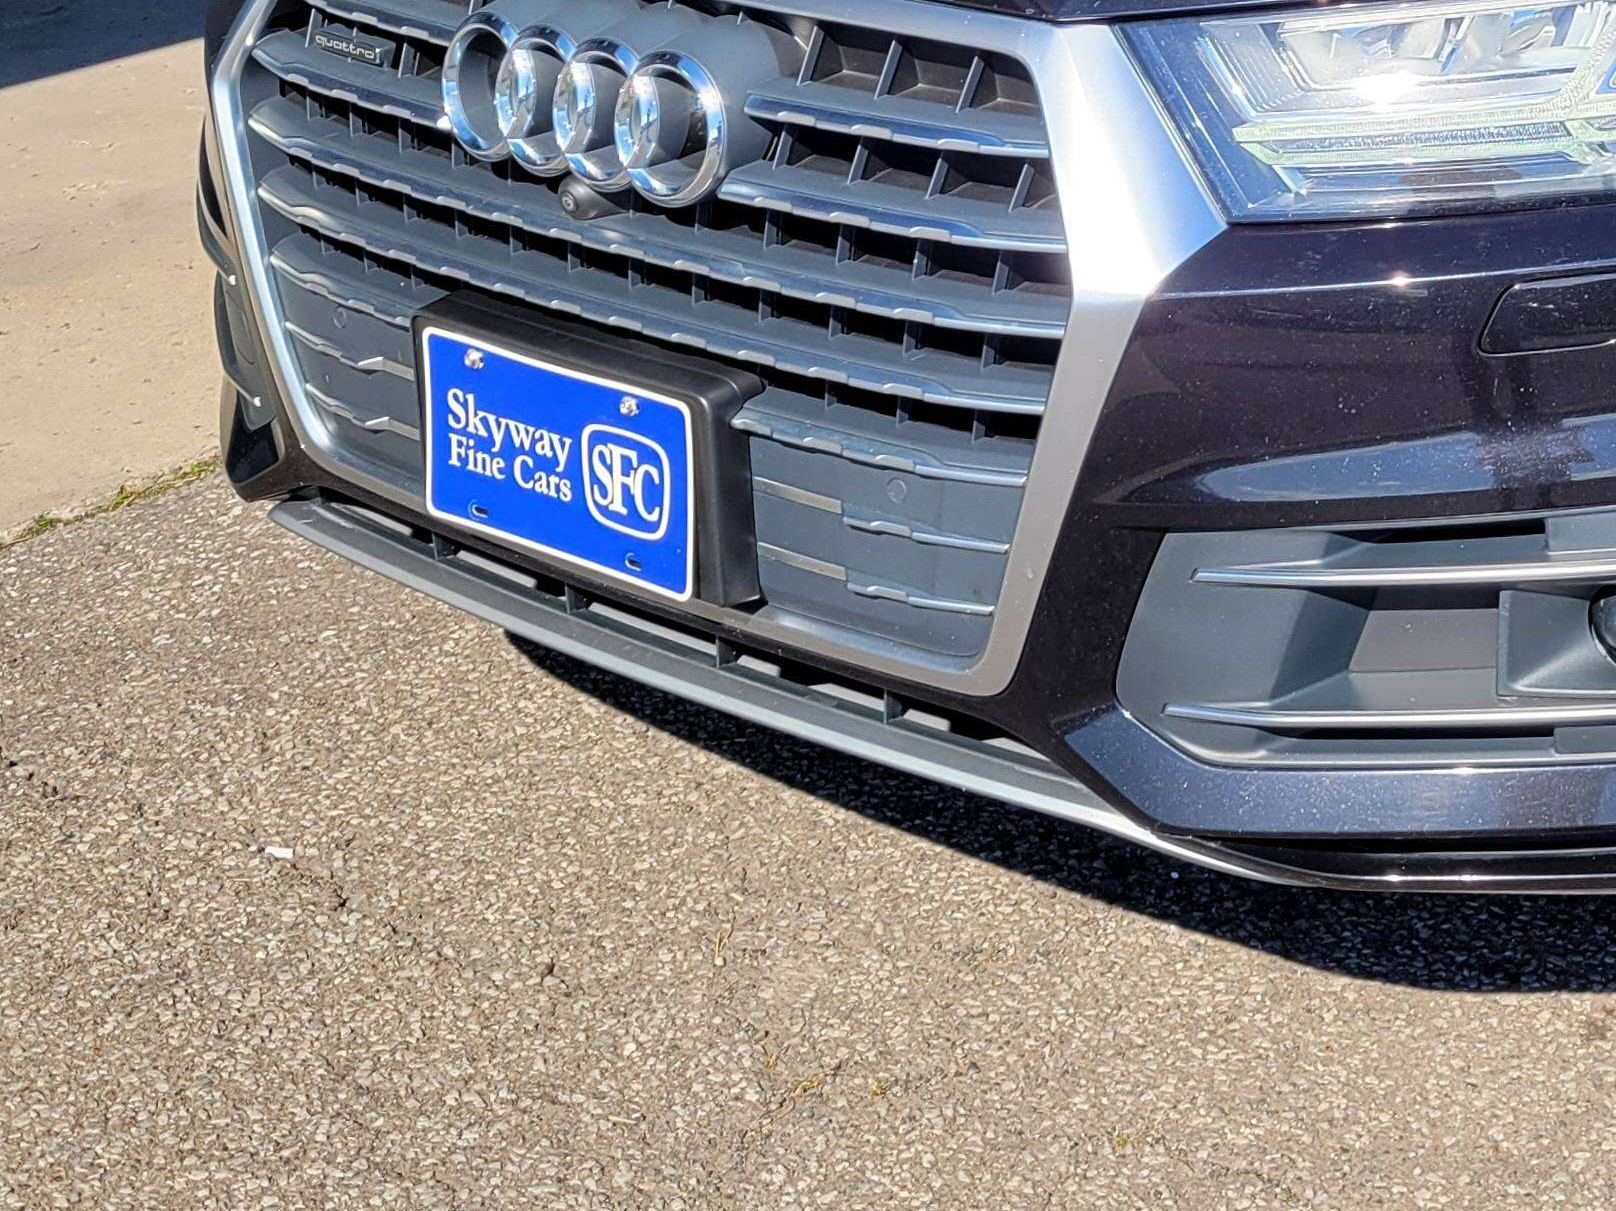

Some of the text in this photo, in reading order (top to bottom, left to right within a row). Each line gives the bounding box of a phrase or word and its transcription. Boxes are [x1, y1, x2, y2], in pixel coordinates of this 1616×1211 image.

[315, 35, 375, 59] quattro
[447, 388, 572, 472] Skyway
[448, 433, 572, 503] Fine Cars
[592, 443, 660, 522] SFC
